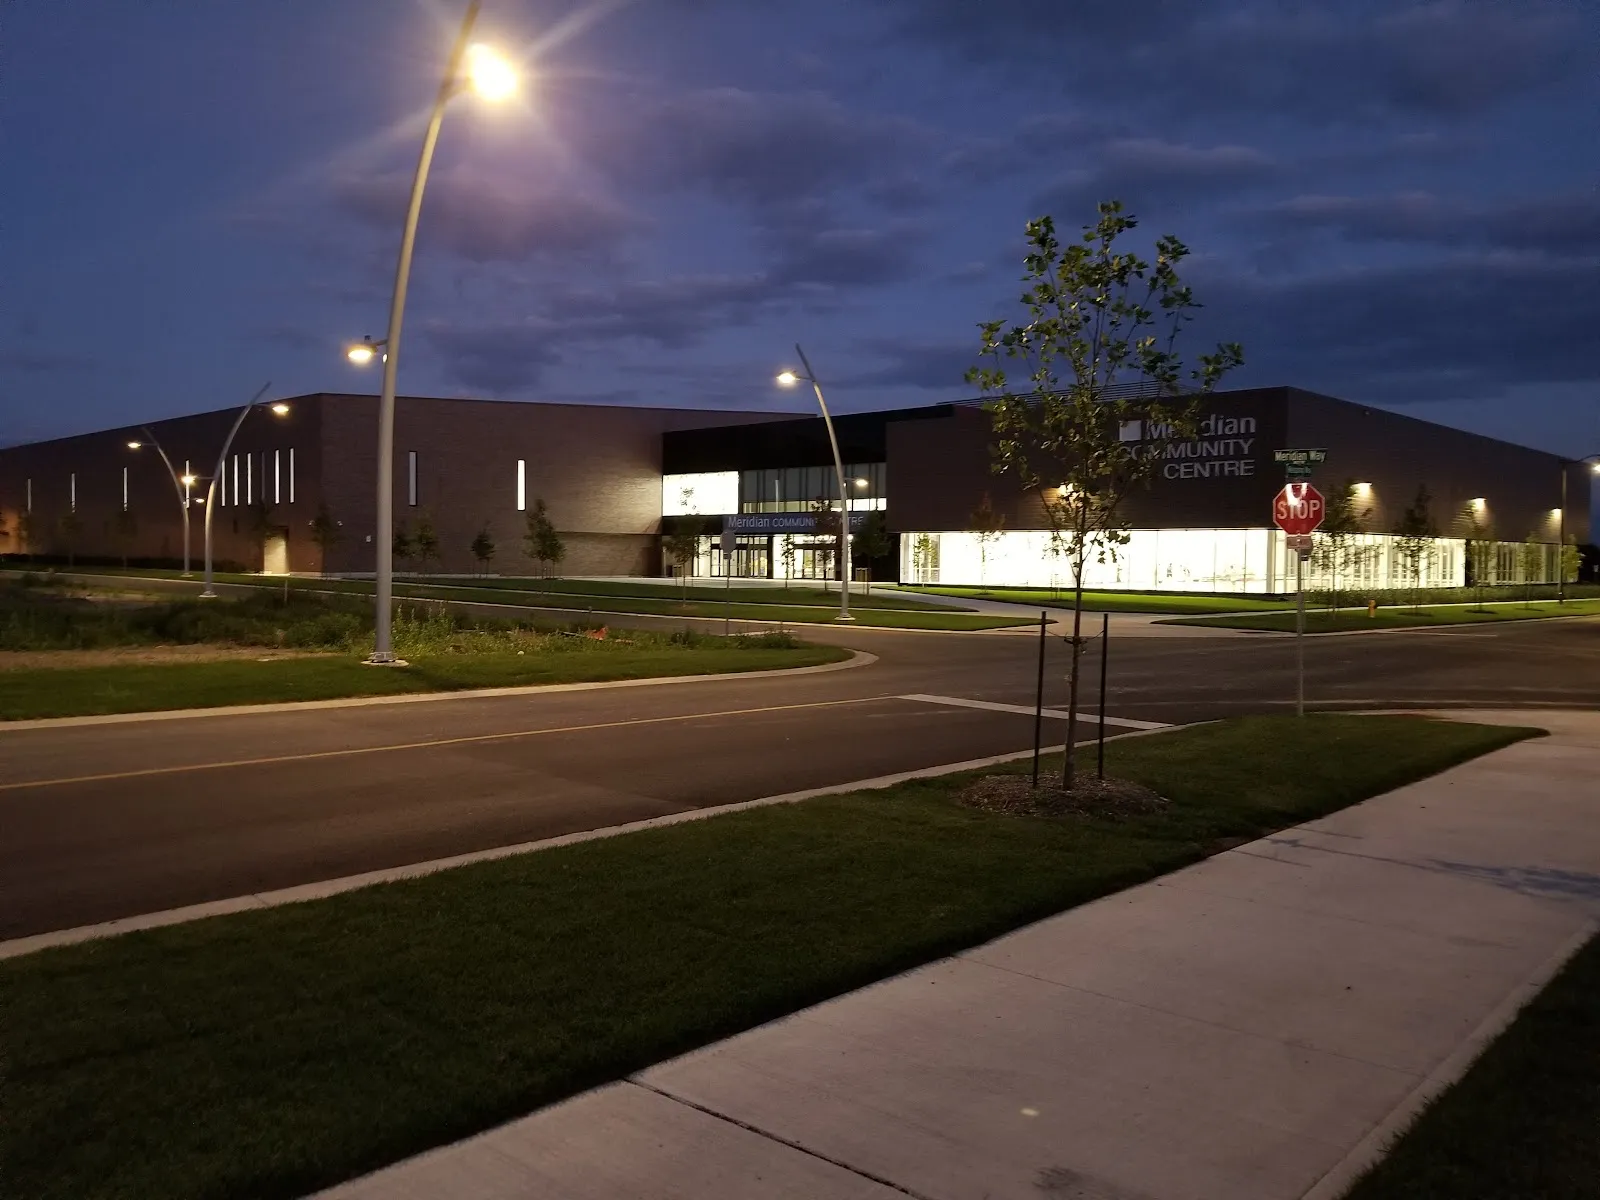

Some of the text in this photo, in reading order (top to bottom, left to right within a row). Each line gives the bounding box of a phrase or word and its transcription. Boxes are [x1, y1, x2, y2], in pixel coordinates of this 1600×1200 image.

[1146, 413, 1256, 440] Median
[1274, 450, 1327, 463] Meridian Way
[1163, 459, 1256, 480] CENTRE
[1276, 499, 1321, 520] STOP
[728, 515, 770, 528] Meridian
[772, 517, 821, 528] COMMUNI
